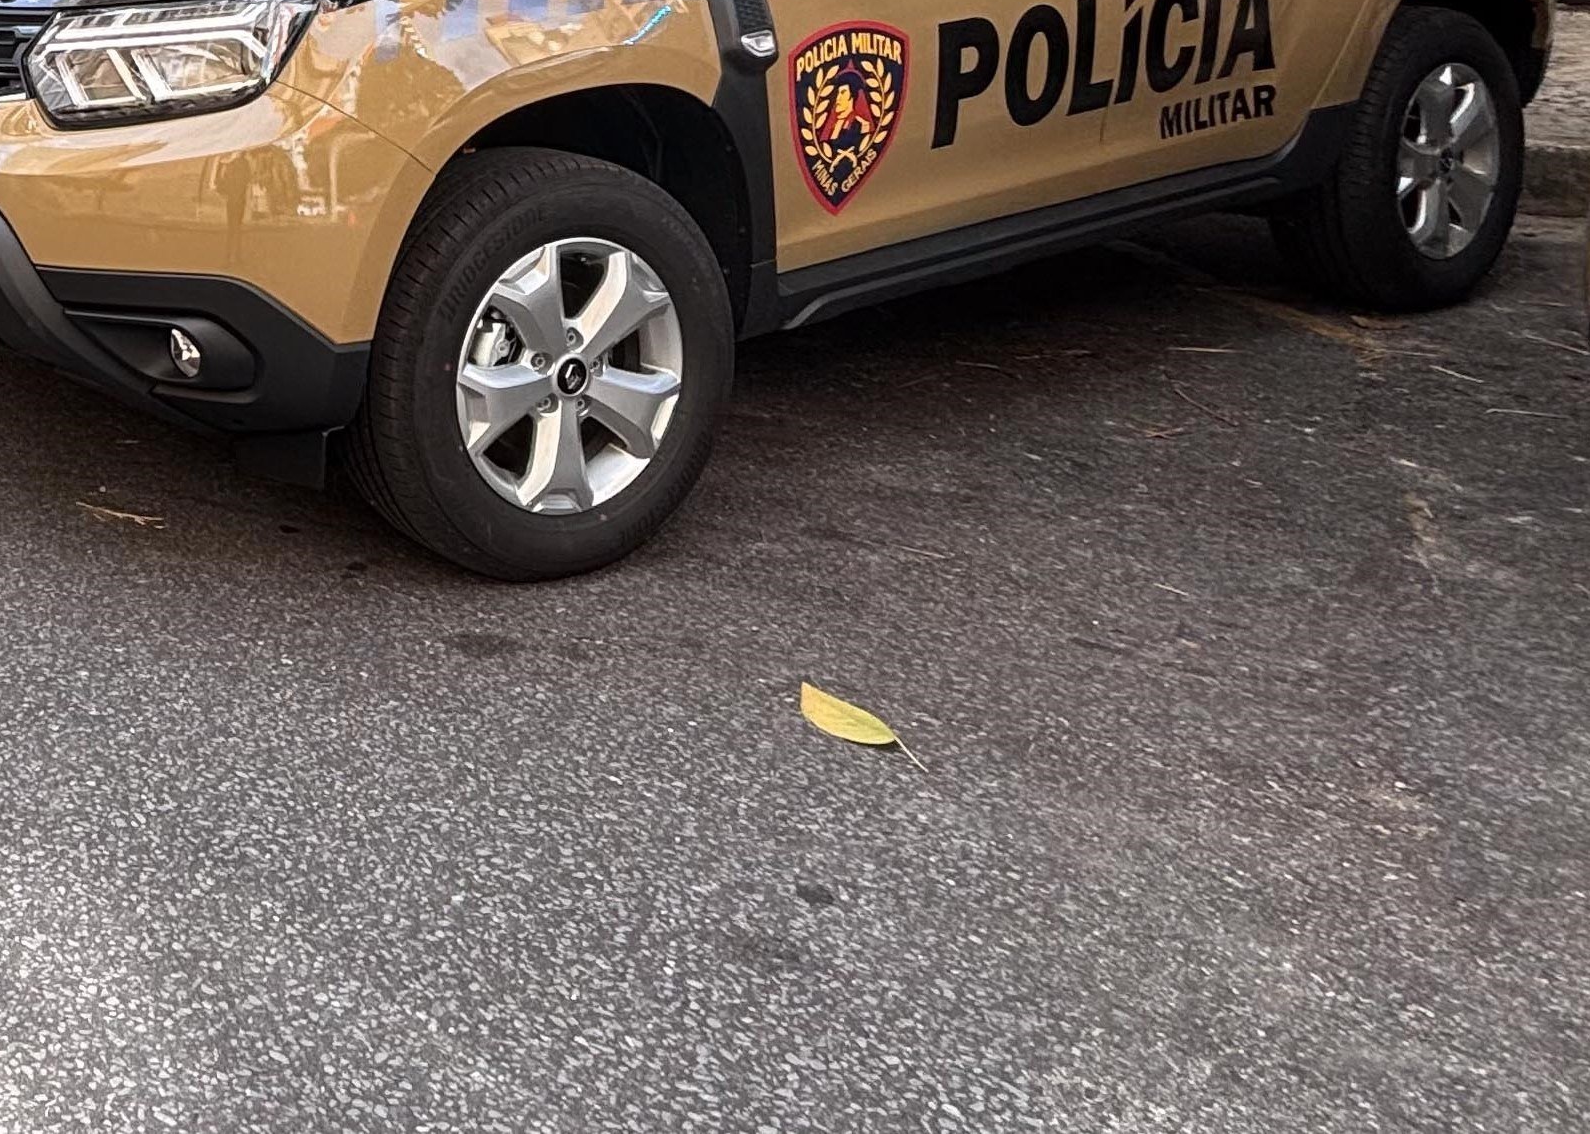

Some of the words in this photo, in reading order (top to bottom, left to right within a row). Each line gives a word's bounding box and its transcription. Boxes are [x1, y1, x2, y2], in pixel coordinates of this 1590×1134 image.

[851, 32, 902, 64] MILITAR
[1160, 84, 1276, 140] MILITAR
[812, 159, 839, 196] MINAS
[840, 148, 878, 193] GERAIS
